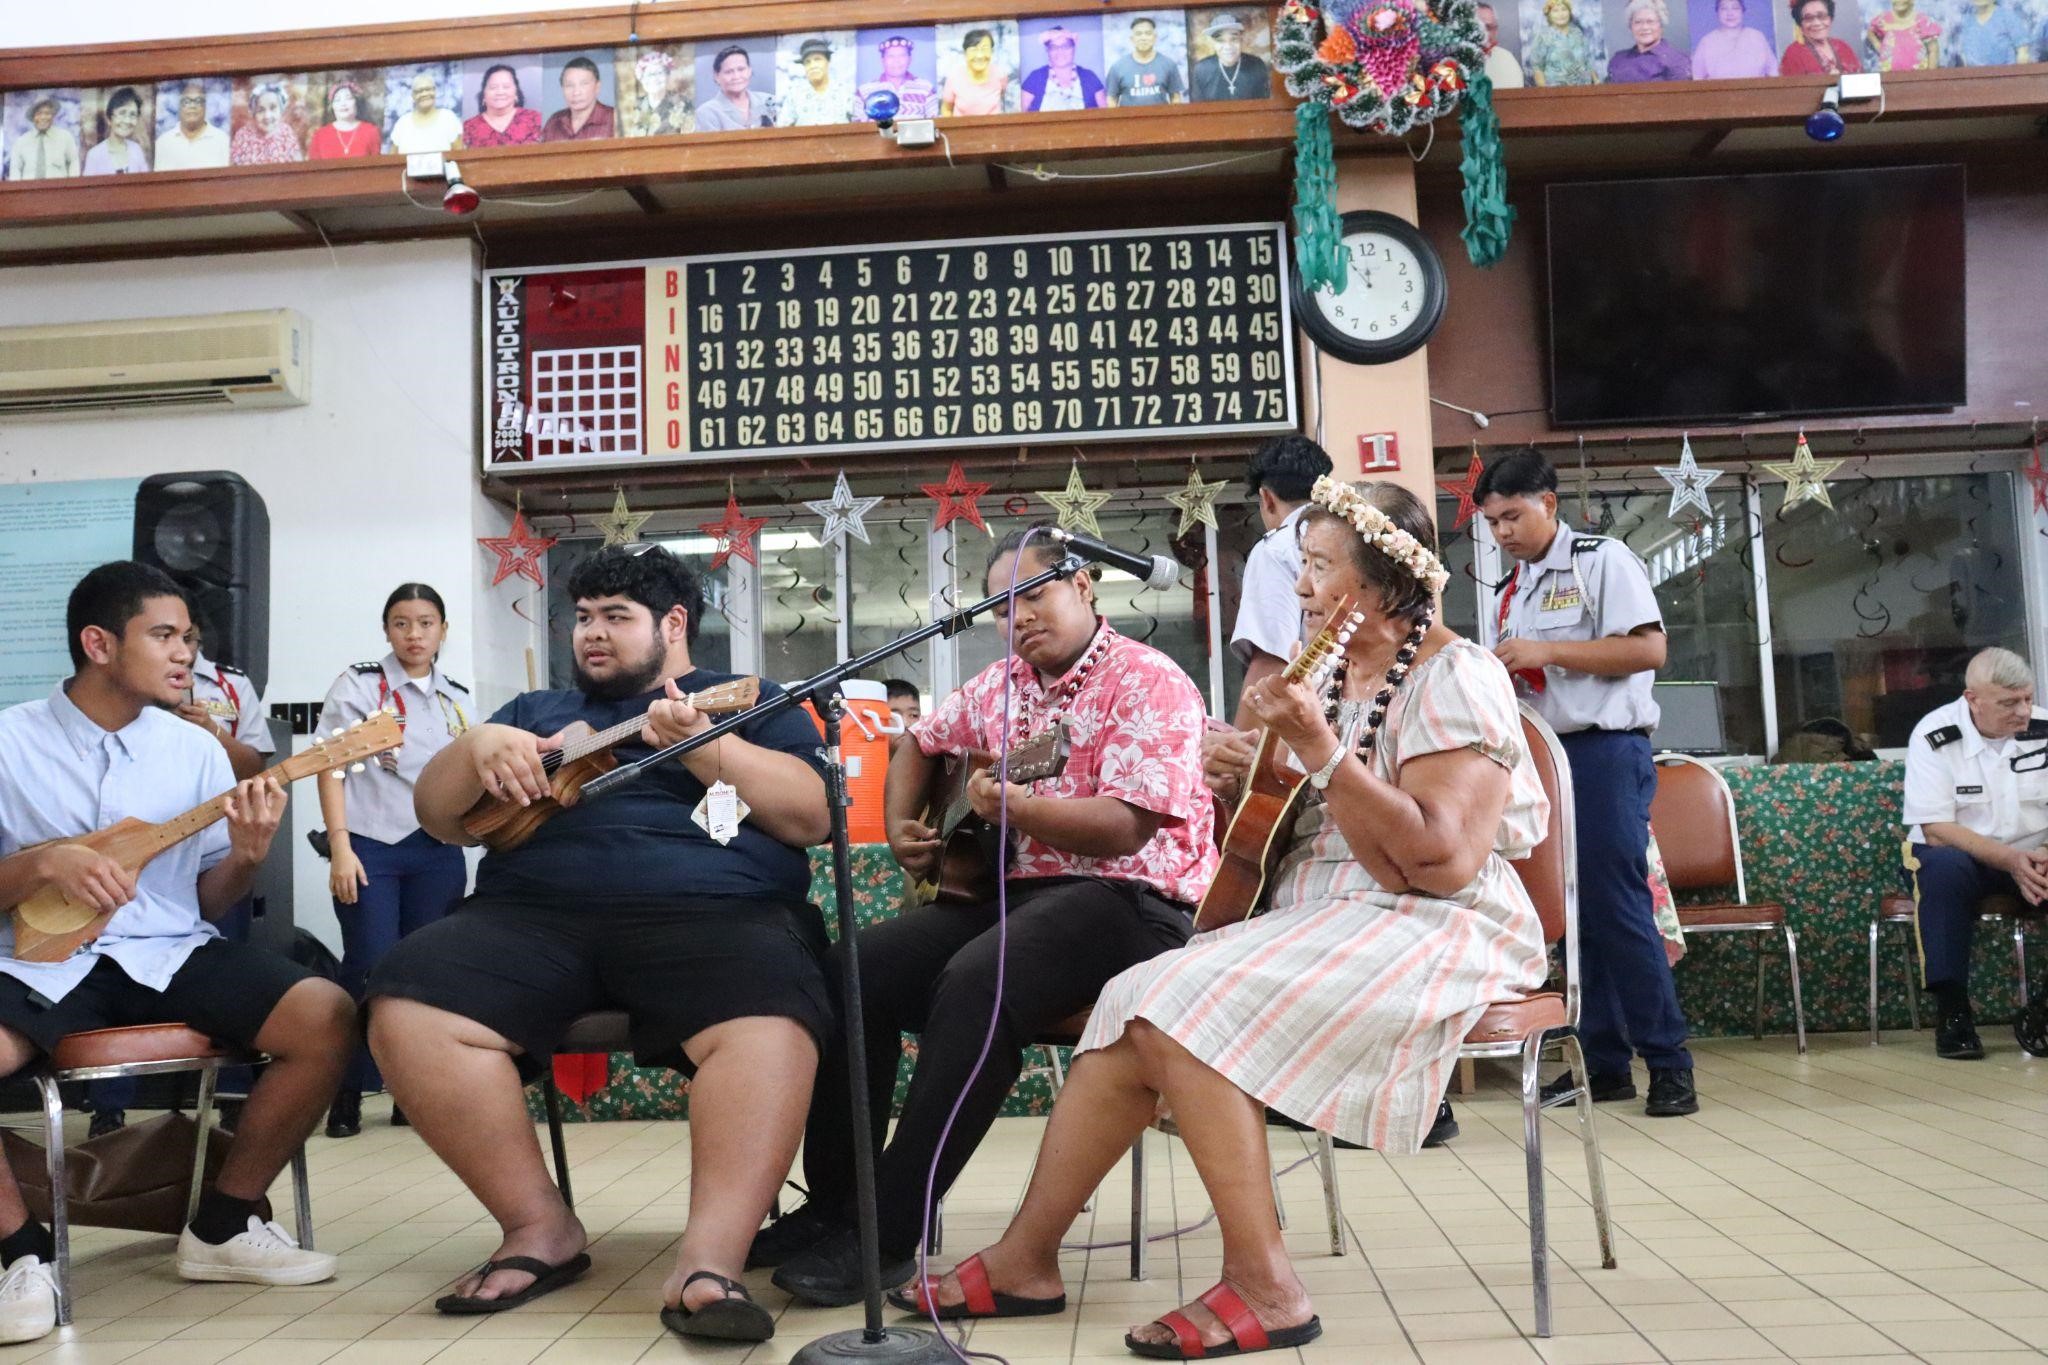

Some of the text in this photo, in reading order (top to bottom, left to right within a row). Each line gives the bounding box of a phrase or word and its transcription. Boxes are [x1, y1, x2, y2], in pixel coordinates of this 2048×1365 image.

[1359, 243, 1376, 256] 12
[1385, 248, 1392, 261] 1
[706, 237, 1271, 296] 1 2 3 4 5 6 7 8 9 10 11 12 13 14 15
[1399, 262, 1407, 275] 2
[1404, 280, 1413, 293] 3
[699, 274, 1275, 333] 16 17 18 19 20 21 22 23 24 25 26 27 28 29 30
[1401, 300, 1410, 312] 4
[1335, 306, 1344, 318] 8
[1351, 318, 1359, 329] 7
[1370, 321, 1379, 333] 6
[1390, 314, 1398, 327] 5
[699, 312, 1278, 371] 31 32 33 34 35 36 37 38 39 40 41 42 43 44 45
[666, 271, 680, 448] BINGO
[698, 350, 1280, 409] 46 47 48 49 50 51 52 53 54 55 56 57 58 59 60
[700, 389, 1283, 448] 61 62 63 64 65 66 67 68 69 70 71 72 73 74 75
